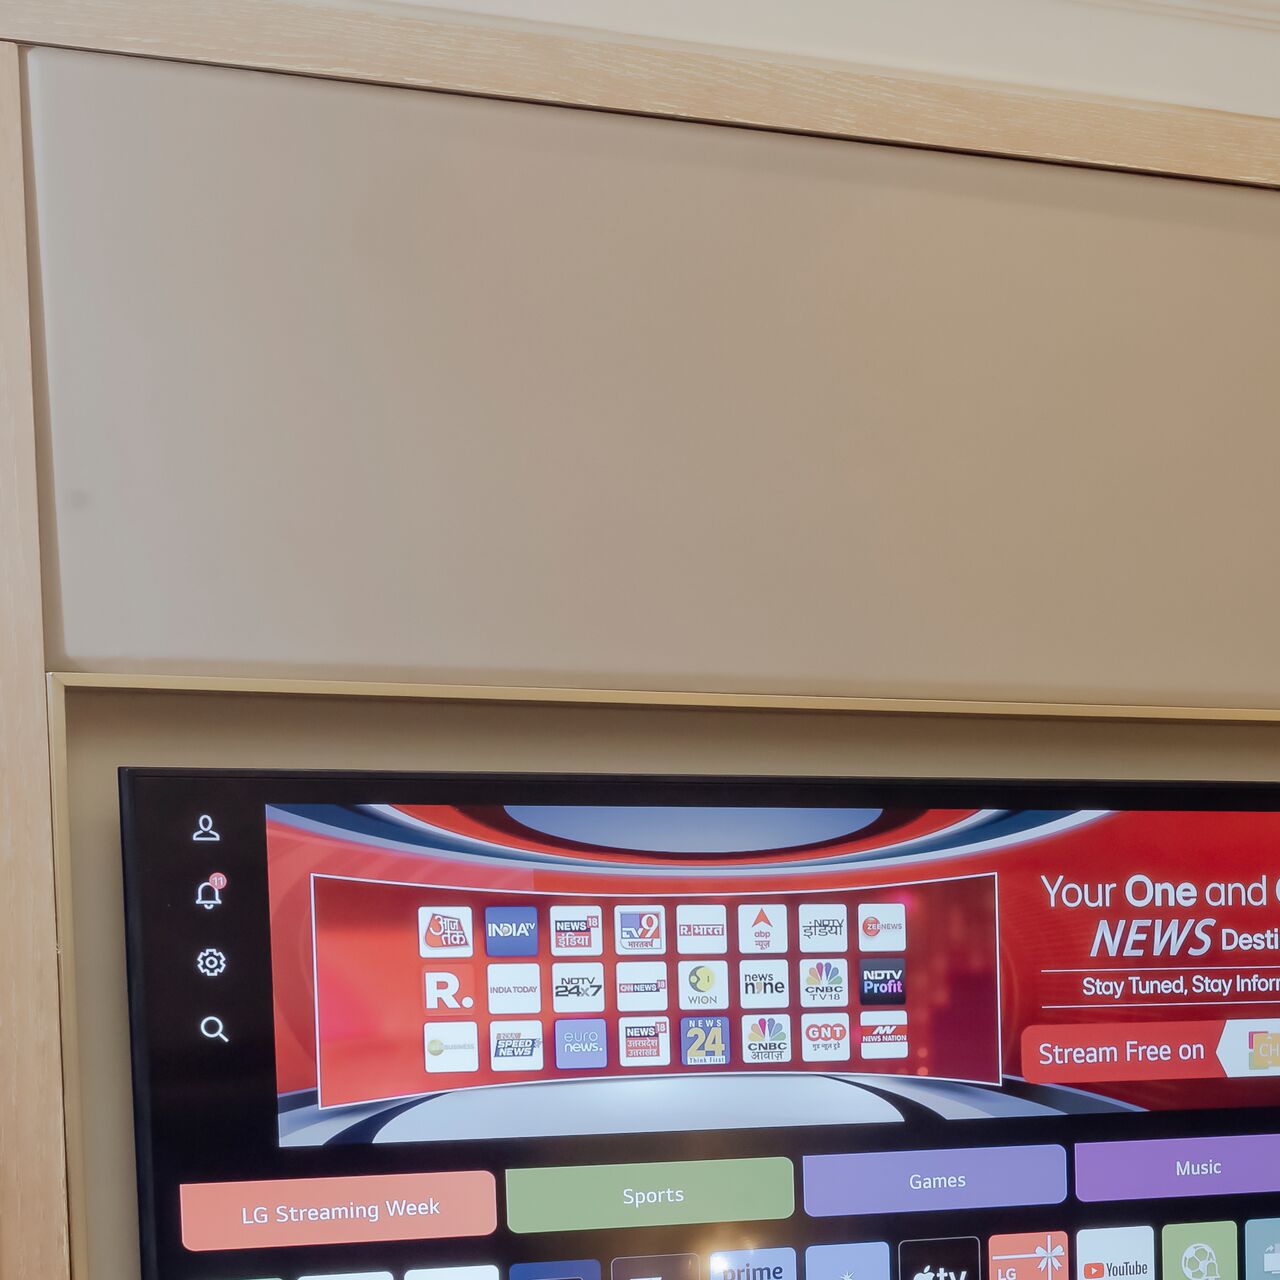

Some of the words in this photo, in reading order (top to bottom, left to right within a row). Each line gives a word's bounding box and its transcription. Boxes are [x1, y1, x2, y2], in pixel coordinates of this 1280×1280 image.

[1040, 875, 1117, 908] Your
[1125, 875, 1198, 907] One
[1205, 875, 1267, 906] and
[557, 922, 586, 931] NEWS
[588, 917, 598, 927] 18
[557, 933, 589, 947] इंडिया
[755, 930, 770, 940] abp
[1090, 919, 1216, 957] NEWS
[561, 977, 596, 985] NDTV
[744, 973, 774, 982] news
[864, 970, 902, 980] NDTV
[490, 986, 512, 994] INDIA
[513, 985, 538, 993] TODAY
[634, 984, 657, 992] NEWS
[864, 979, 903, 994] Profit
[1082, 977, 1125, 999] Stay
[1127, 976, 1188, 996] Tuned,
[1191, 975, 1233, 997] Stay
[688, 995, 717, 1004] WION
[810, 993, 840, 1001] TV18
[627, 1027, 655, 1036] NEWS
[656, 1023, 665, 1031] 18
[689, 1019, 722, 1027] NEWS
[564, 1031, 598, 1041] euro
[808, 1026, 843, 1039] GNT
[498, 1040, 533, 1048] SPEED
[687, 1027, 725, 1057] 24
[748, 1042, 787, 1050] CNBC
[499, 1048, 531, 1056] NEWS
[1039, 1043, 1118, 1065] Stream
[1126, 1041, 1171, 1062] Free
[1178, 1043, 1205, 1060] on
[1259, 1043, 1280, 1057] CH
[1176, 1159, 1222, 1176] Music
[909, 1173, 966, 1190] Games
[623, 1188, 684, 1208] Sports
[242, 1206, 269, 1225] LG
[276, 1202, 380, 1223] Streaming
[385, 1198, 441, 1217] Week
[1106, 1260, 1148, 1278] YouTube
